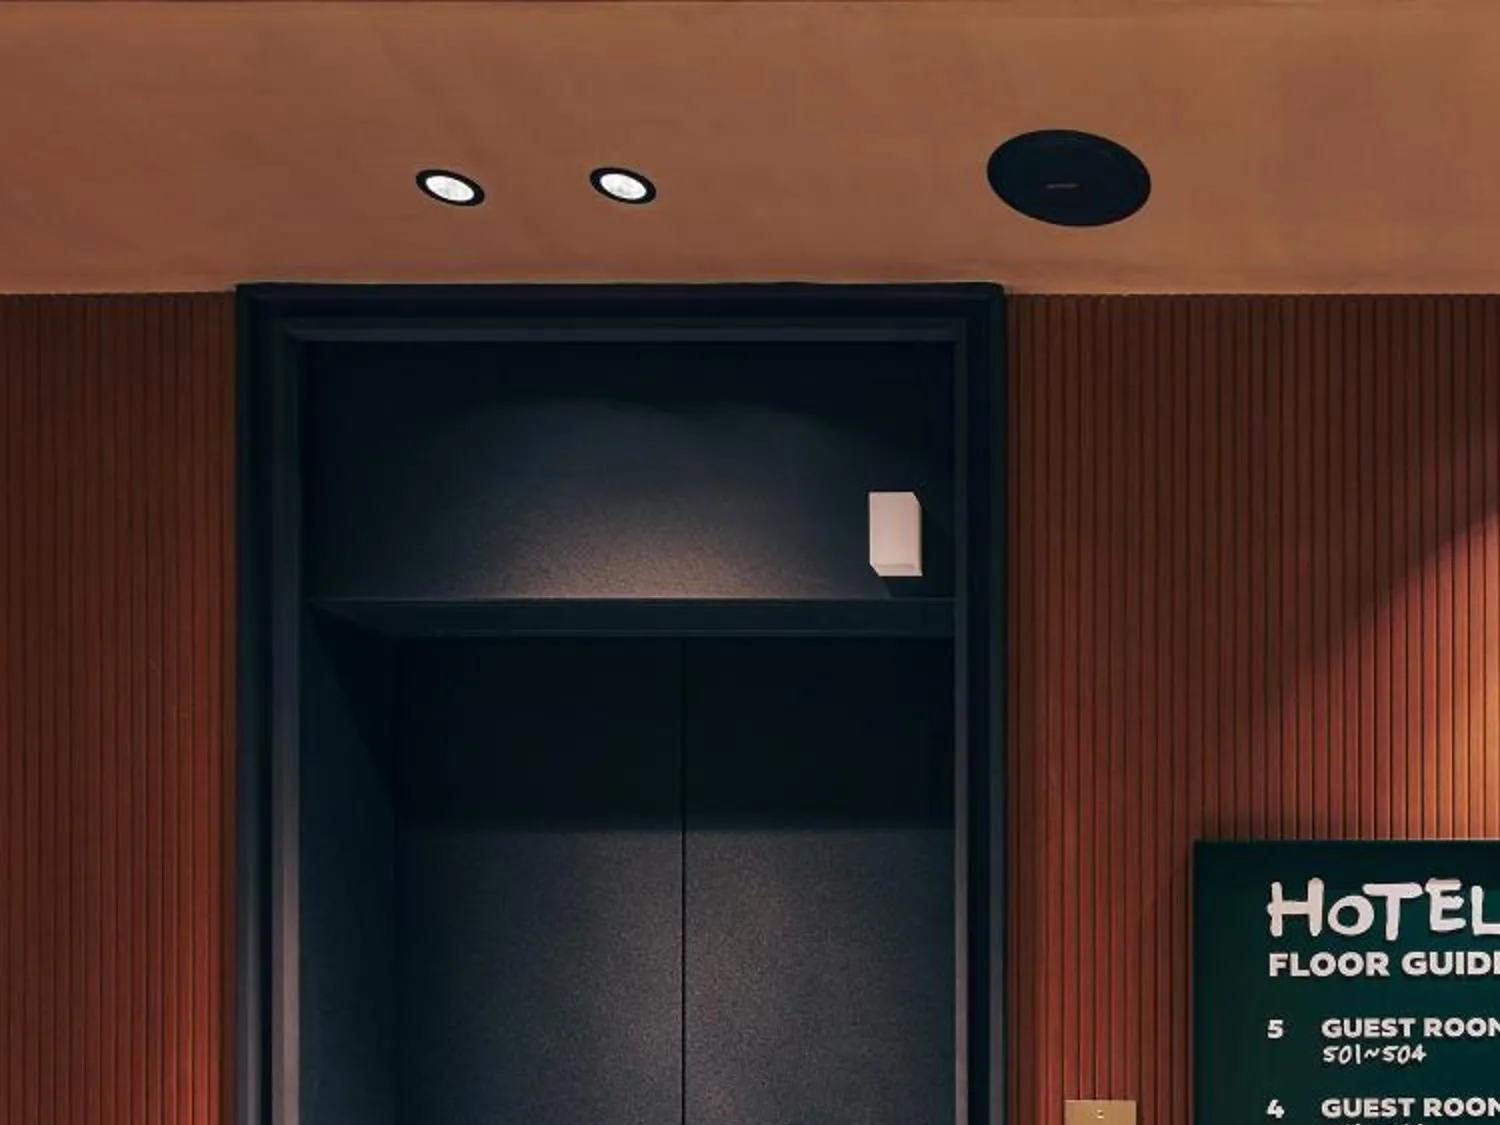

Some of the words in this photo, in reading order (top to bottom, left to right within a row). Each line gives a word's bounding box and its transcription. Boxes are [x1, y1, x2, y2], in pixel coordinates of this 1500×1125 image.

[1269, 951, 1390, 977] FLOOR
[1267, 1019, 1284, 1039] 5
[1321, 1017, 1416, 1039] GUEST
[1266, 1099, 1285, 1119] 4
[1321, 1097, 1416, 1119] GUEST
